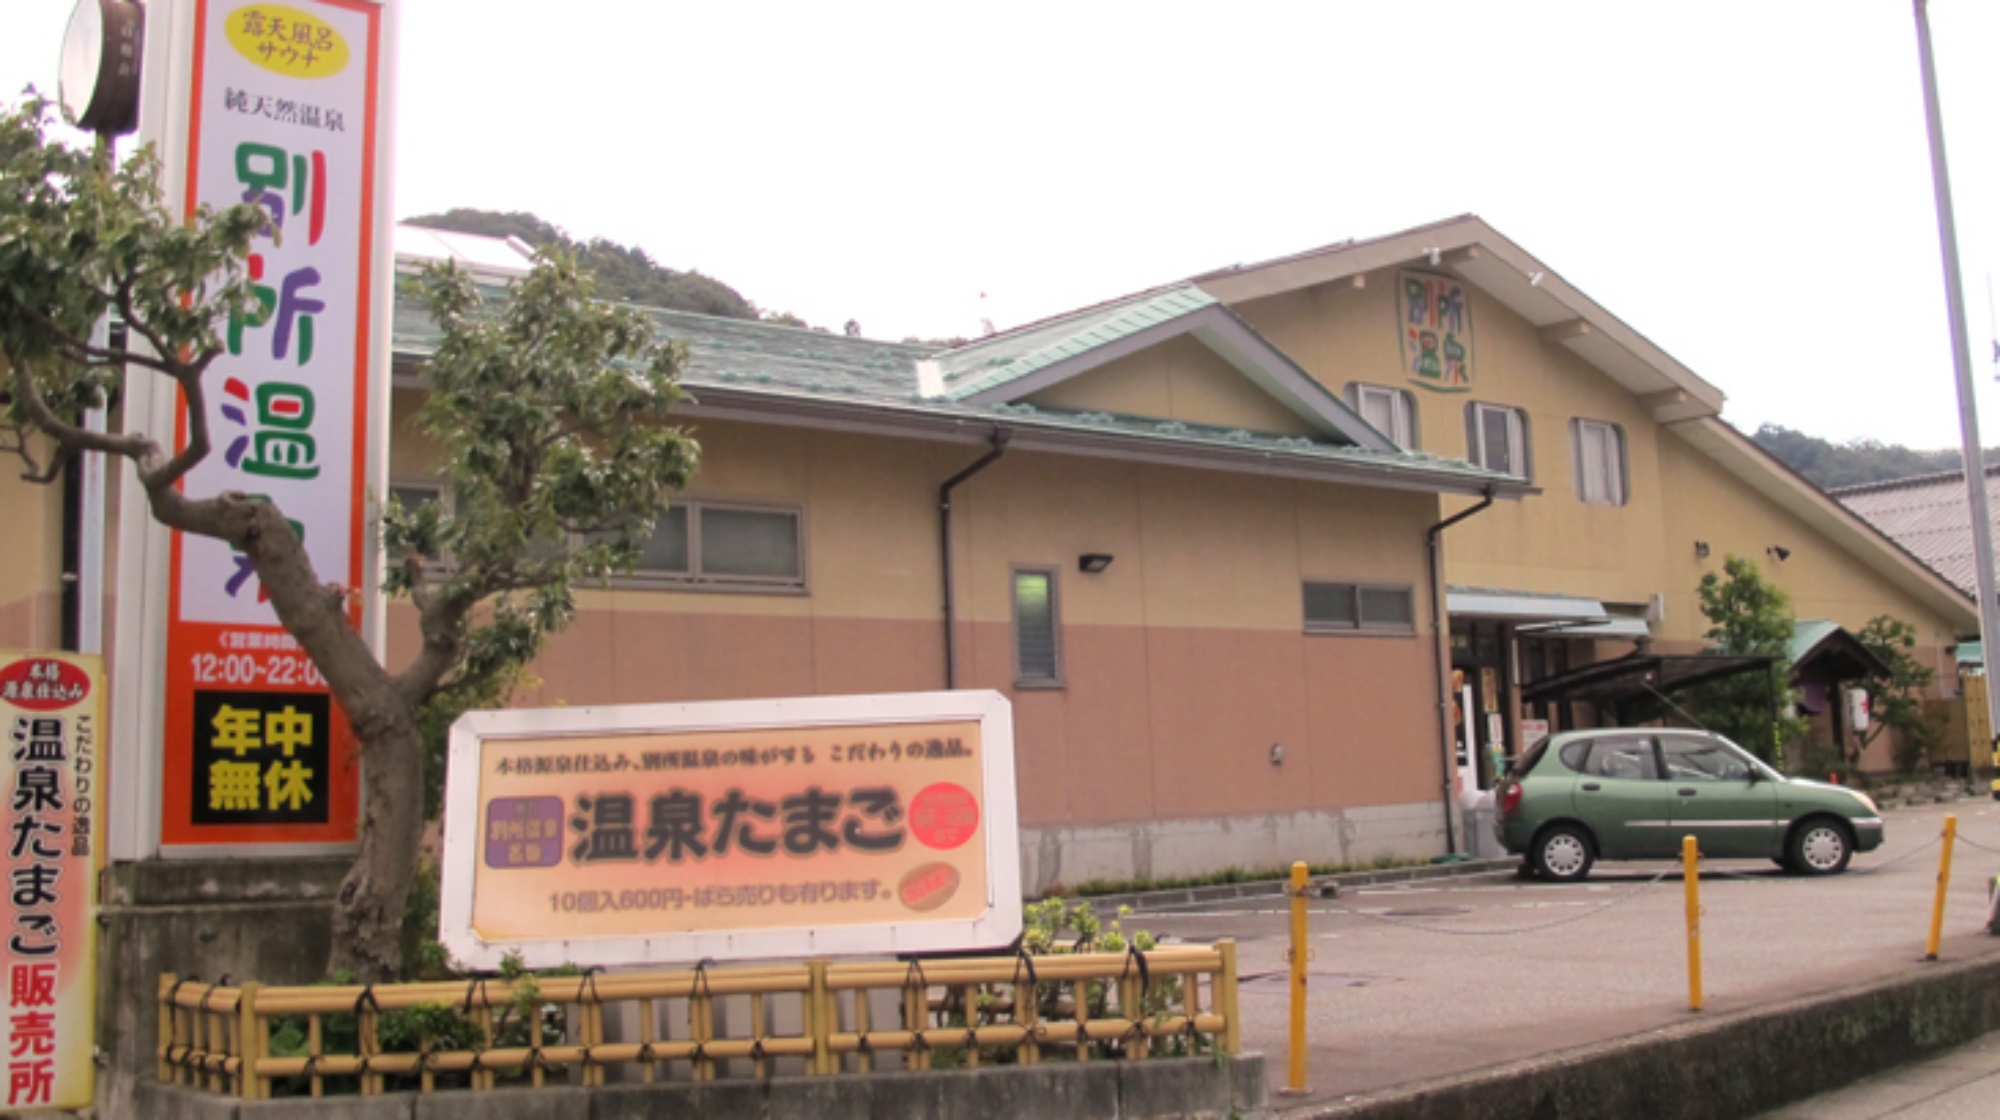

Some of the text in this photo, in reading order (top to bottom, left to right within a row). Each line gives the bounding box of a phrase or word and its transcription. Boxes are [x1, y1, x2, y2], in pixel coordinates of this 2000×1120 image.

[243, 10, 333, 52] 露天風呂
[257, 41, 320, 70] サウナ
[224, 86, 345, 132] 純天然温泉
[1404, 277, 1463, 333] 別所
[221, 142, 327, 605] 別所温
[211, 703, 313, 756] 年中
[71, 715, 92, 857] こだわりの逸品
[209, 759, 313, 811] 無休
[570, 787, 906, 865] 温泉たまご
[8, 717, 66, 1104] 温泉たまご販売所
